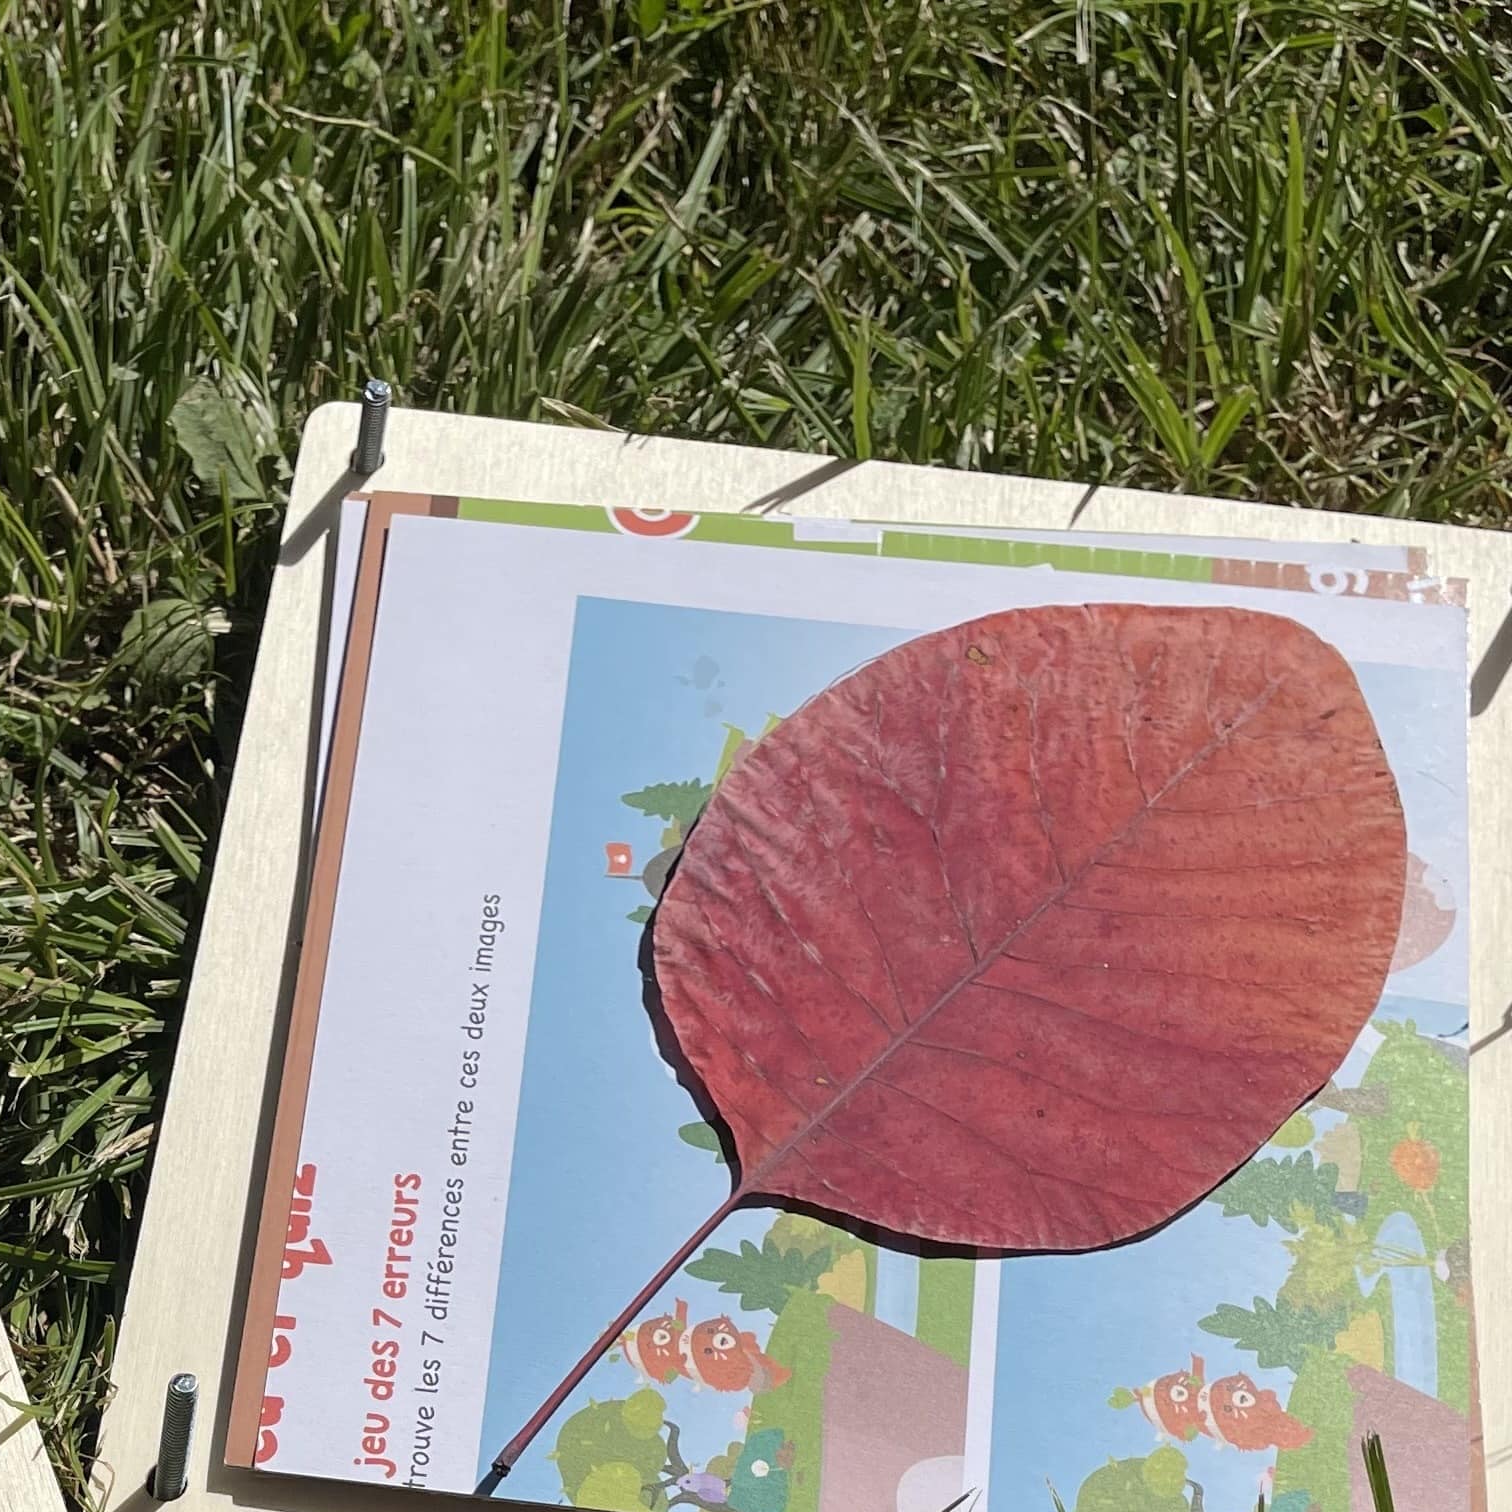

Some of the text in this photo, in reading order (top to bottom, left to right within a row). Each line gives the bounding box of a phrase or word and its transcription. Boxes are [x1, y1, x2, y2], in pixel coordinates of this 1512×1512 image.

[353, 1172, 422, 1480] jeu des 7 erreurs
[402, 893, 505, 1488] trouve les 7 différences entre ces deux images
